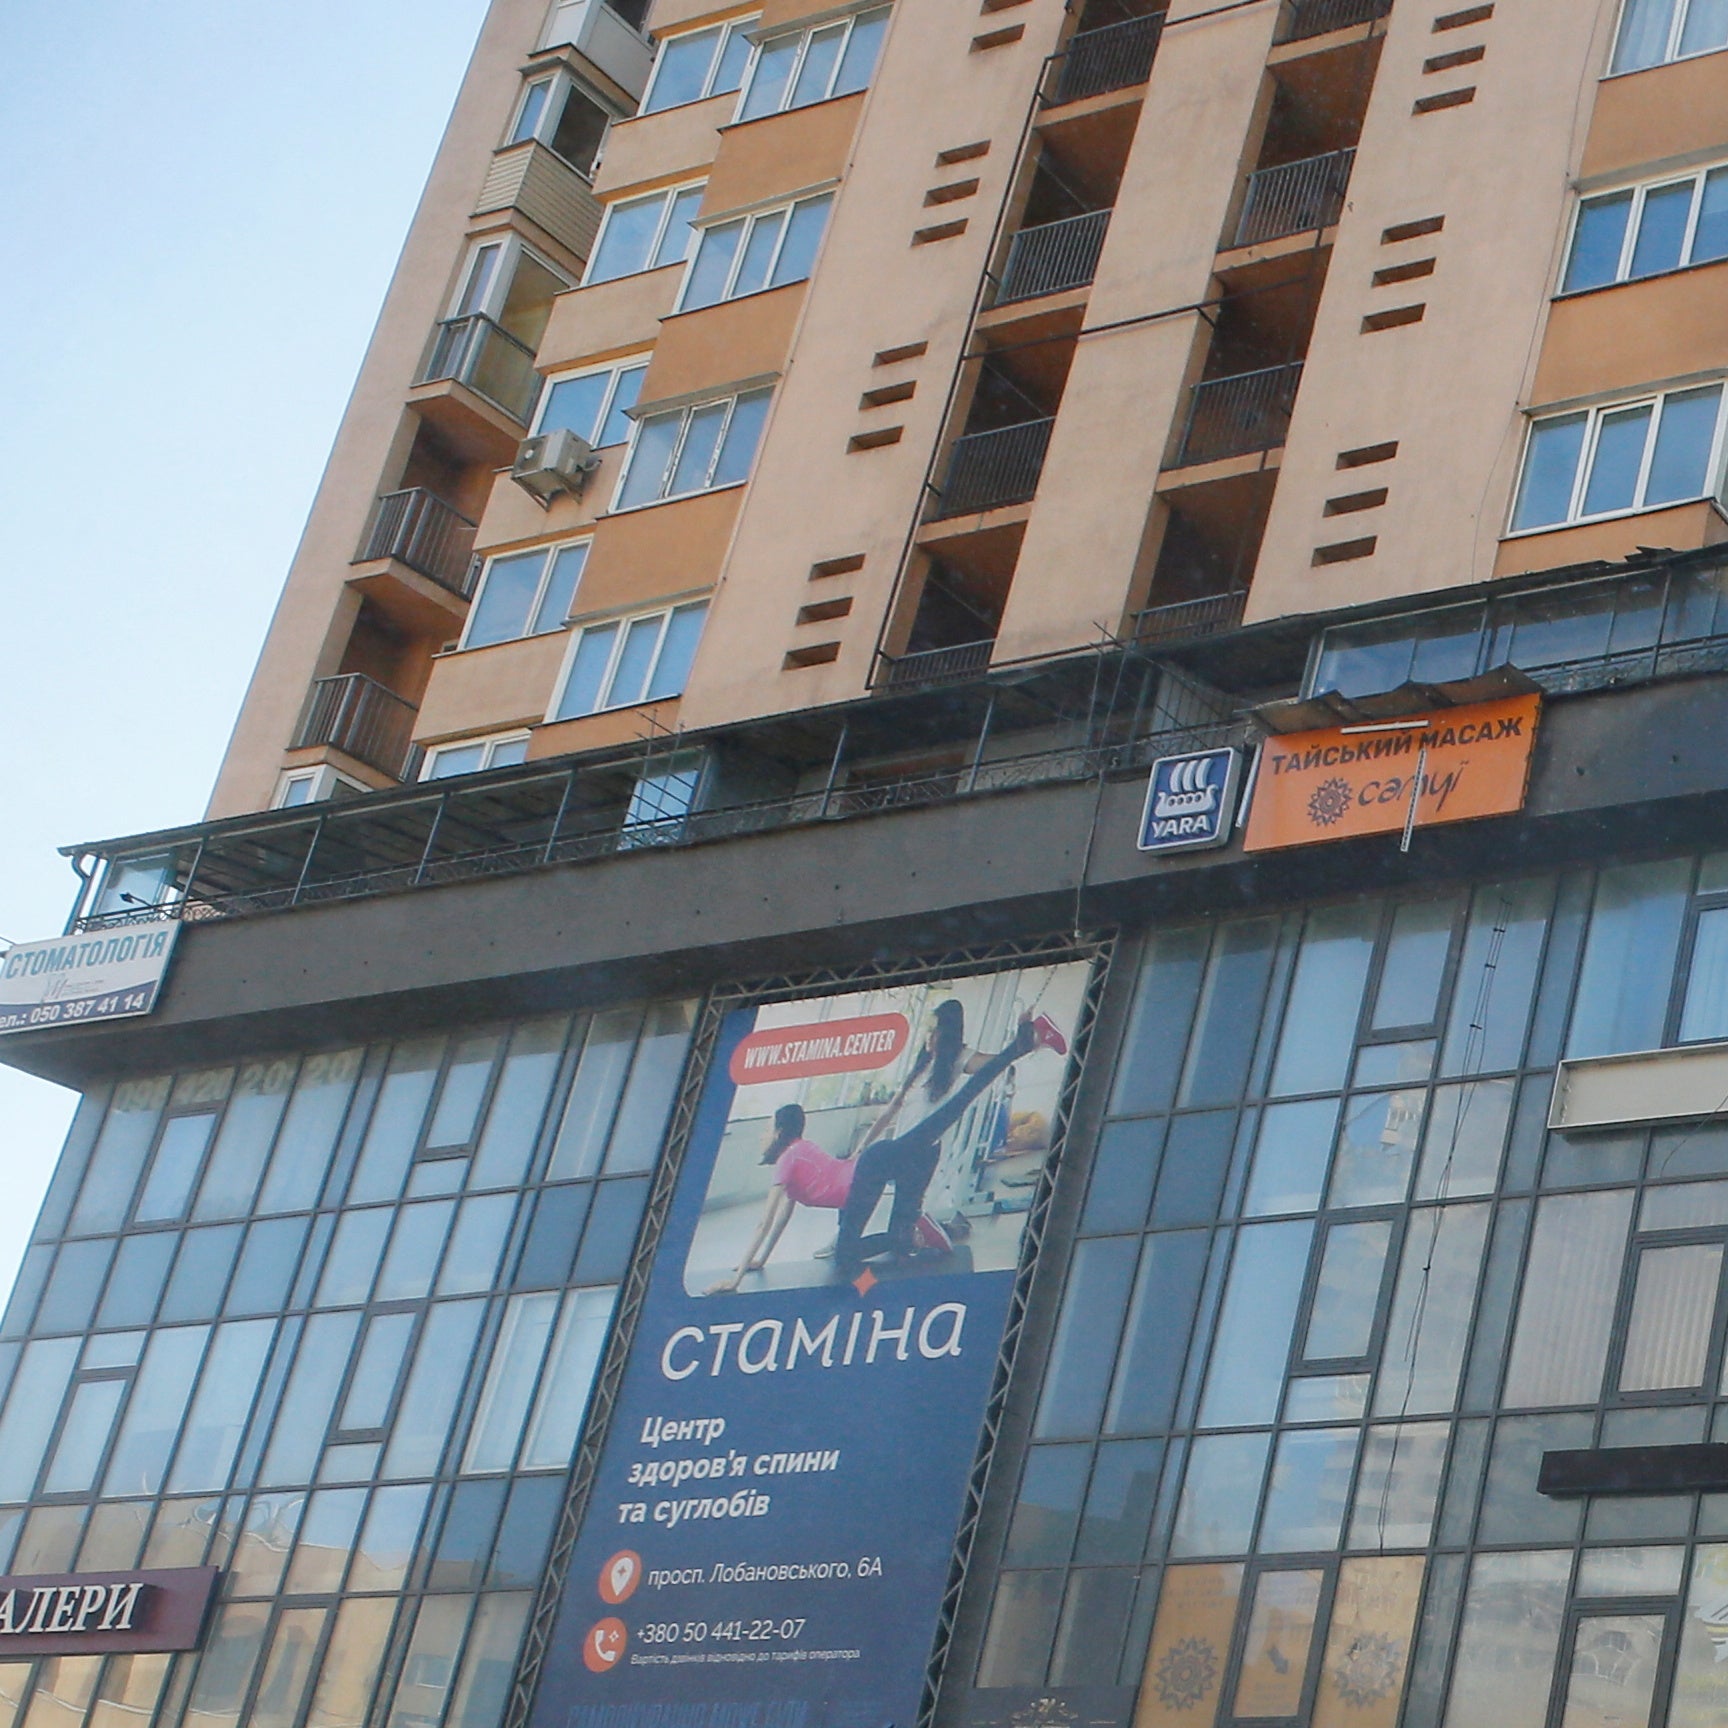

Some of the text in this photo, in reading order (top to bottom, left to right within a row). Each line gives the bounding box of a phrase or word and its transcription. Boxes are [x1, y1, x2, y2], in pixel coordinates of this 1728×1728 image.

[1271, 716, 1524, 776] ТАЙСЬКИЙ МАСАЖ
[1150, 814, 1210, 838] YARA
[6, 929, 167, 980] СТОМАТОЛОГІЯ
[30, 1005, 60, 1023] 050
[64, 1002, 94, 1020] 387
[97, 996, 118, 1014] 41
[123, 992, 147, 1010] 14
[744, 1028, 896, 1070] WWW.STAMINA.CENTER
[640, 1416, 726, 1448] Центр
[627, 1449, 841, 1488] здоров'я спини
[618, 1488, 771, 1529] та суглобів
[647, 1556, 884, 1591] просп. Лобановського, 6А
[0, 1582, 144, 1635] АЛЕРИ
[636, 1617, 806, 1644] +380 50 441-22-07
[809, 1648, 860, 1661] оператора
